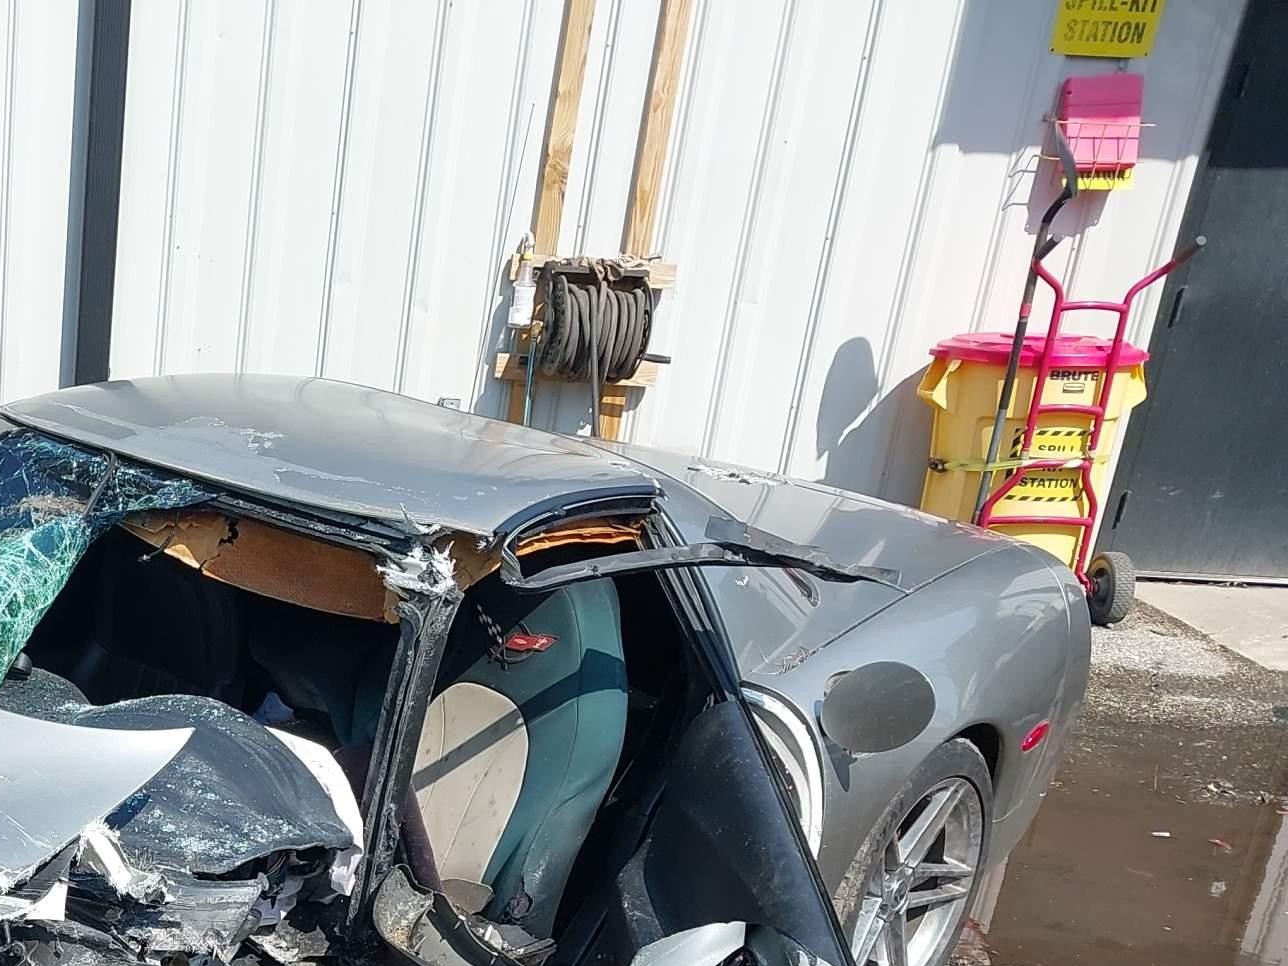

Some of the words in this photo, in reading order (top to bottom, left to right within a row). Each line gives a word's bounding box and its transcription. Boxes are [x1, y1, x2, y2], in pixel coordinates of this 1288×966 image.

[1063, 19, 1146, 44] STATION
[1049, 370, 1100, 381] BRUTE
[1019, 477, 1079, 489] STATION
